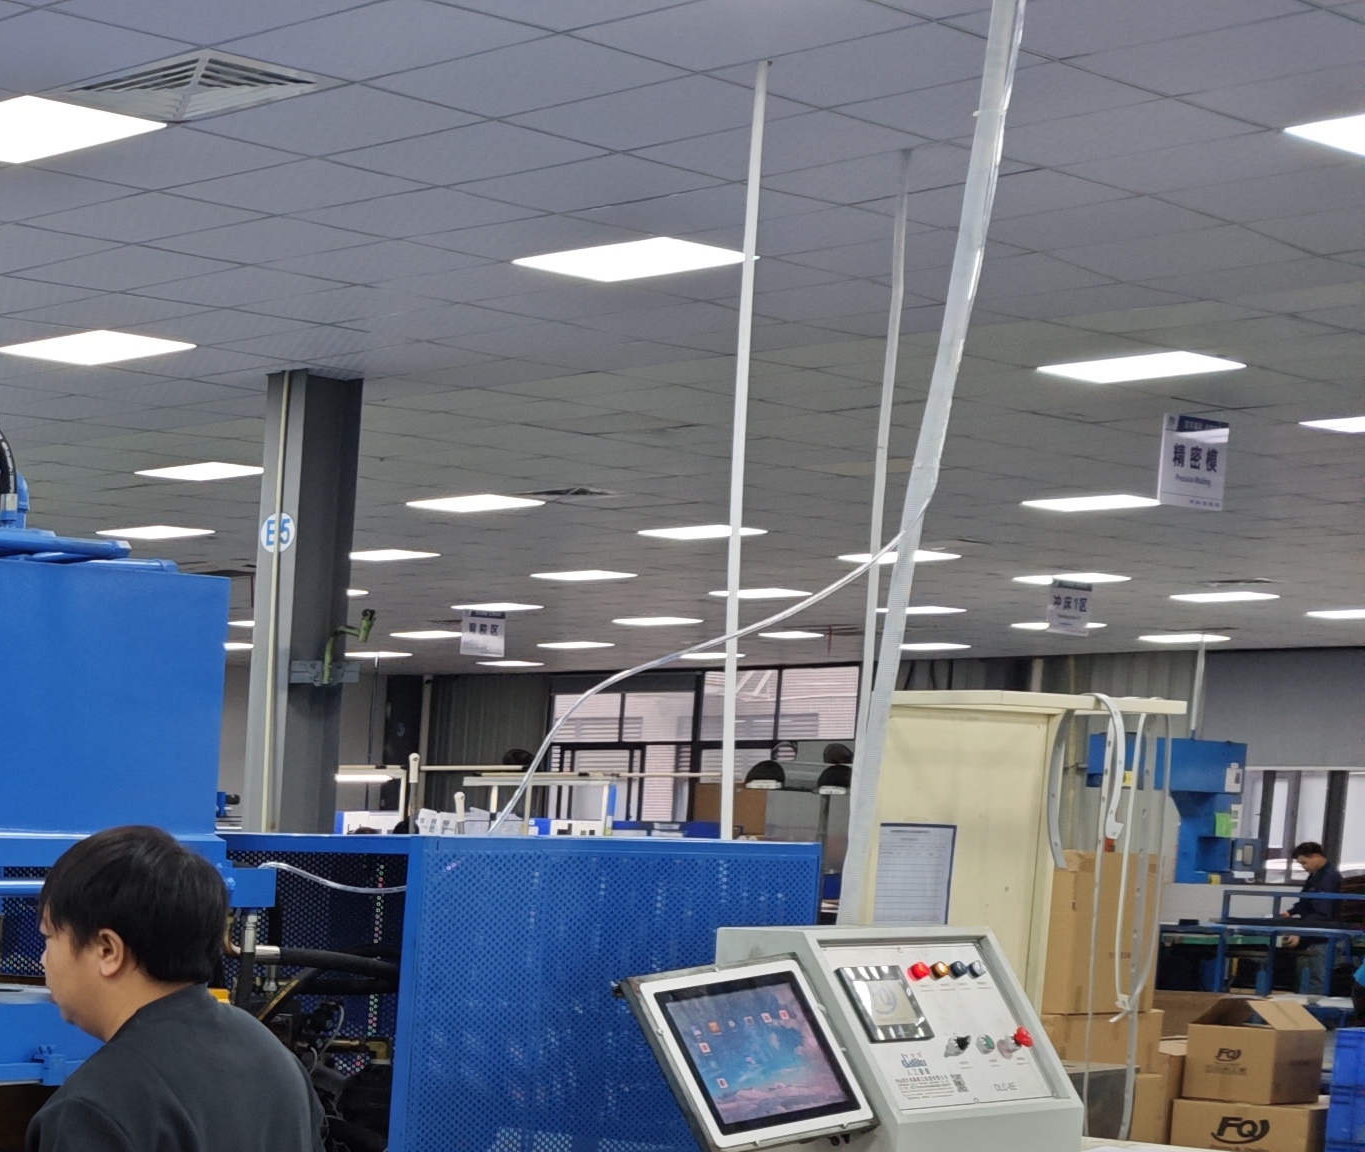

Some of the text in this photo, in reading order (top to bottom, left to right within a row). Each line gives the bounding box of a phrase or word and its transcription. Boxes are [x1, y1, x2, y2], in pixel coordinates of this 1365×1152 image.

[1172, 443, 1219, 473] 精密模
[266, 518, 291, 546] E5
[1213, 1116, 1266, 1142] FQ
